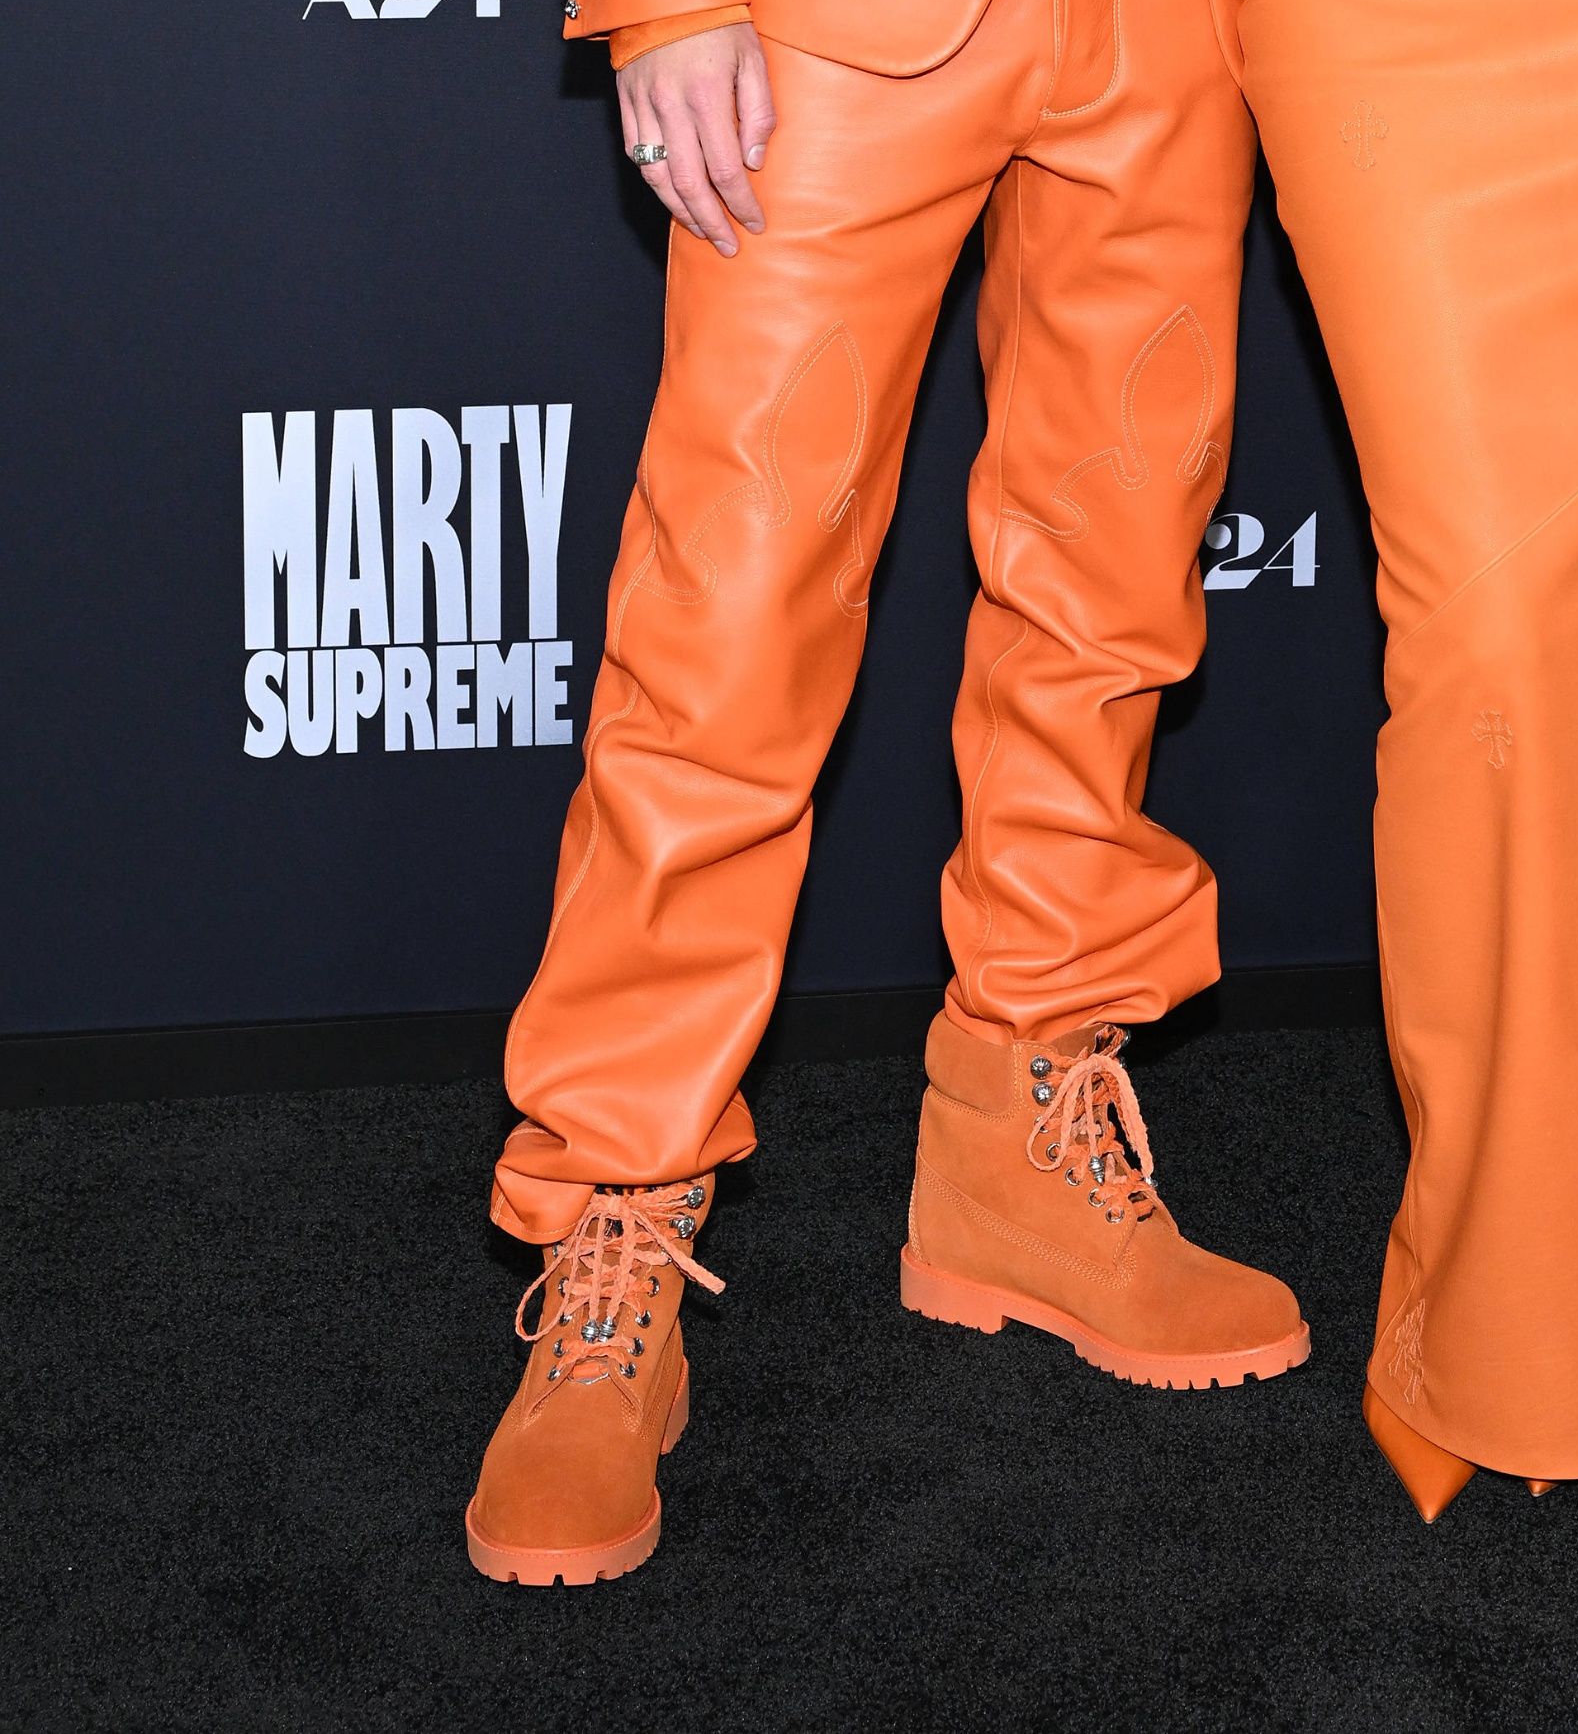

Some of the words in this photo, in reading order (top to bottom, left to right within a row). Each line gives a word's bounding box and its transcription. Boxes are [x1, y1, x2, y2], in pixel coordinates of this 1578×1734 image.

[241, 403, 573, 650] MARTY
[1203, 511, 1321, 591] 24
[243, 641, 574, 759] SUPREME
